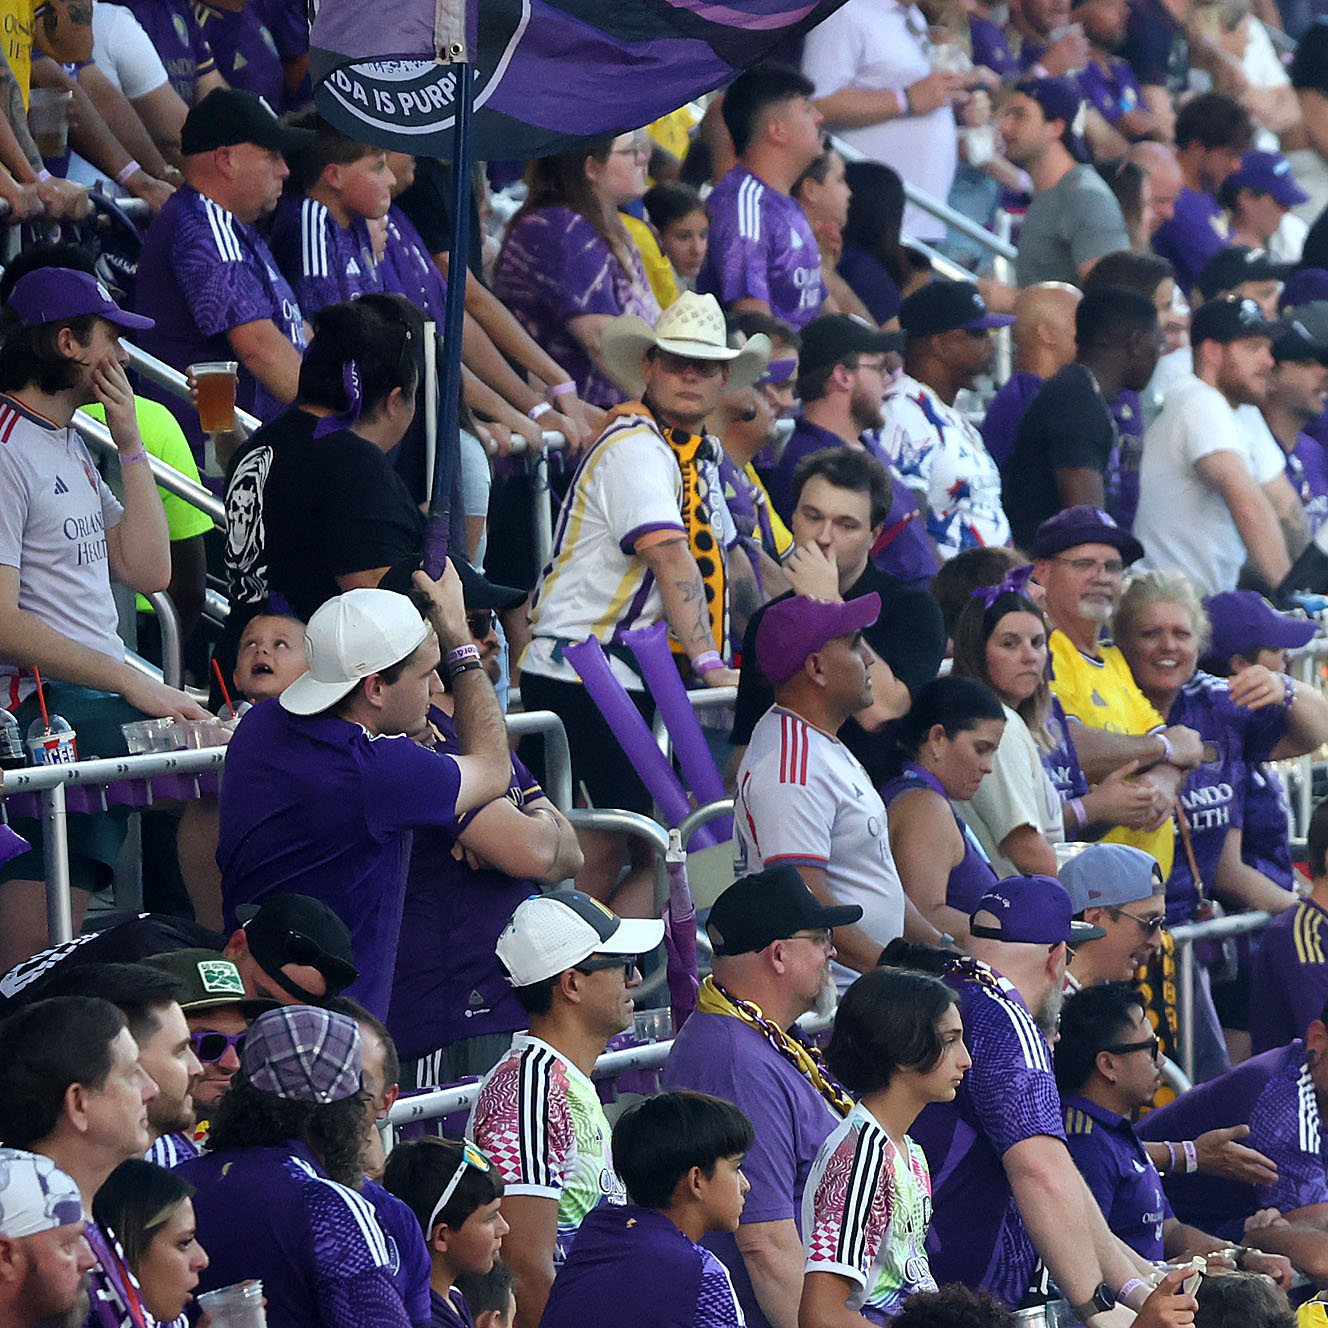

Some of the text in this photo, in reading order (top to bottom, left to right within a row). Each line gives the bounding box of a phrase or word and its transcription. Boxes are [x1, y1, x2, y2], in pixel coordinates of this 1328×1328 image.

[372, 88, 396, 114] IS
[398, 70, 458, 116] PURP
[63, 511, 104, 541] ORLAN
